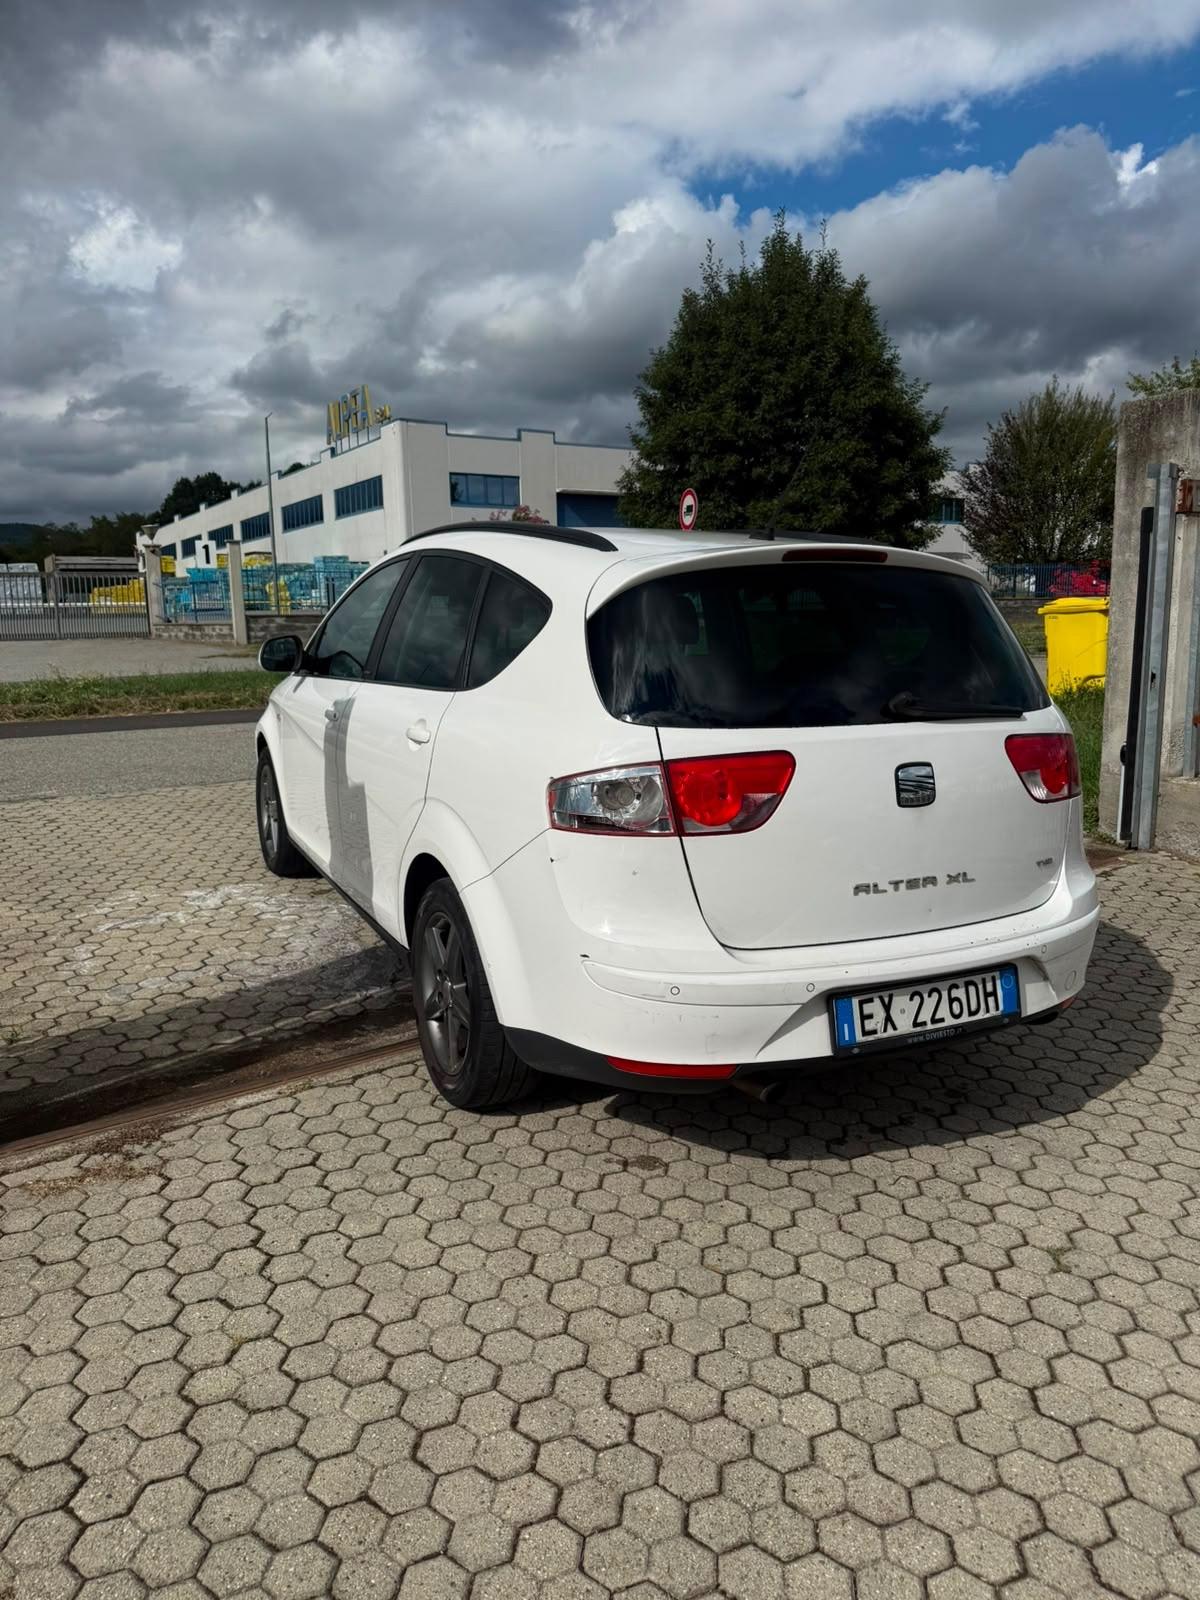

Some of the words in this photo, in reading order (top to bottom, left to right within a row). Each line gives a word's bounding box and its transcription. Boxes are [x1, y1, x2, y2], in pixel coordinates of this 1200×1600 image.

[202, 544, 210, 564] 1
[853, 876, 938, 896] ALTEA
[946, 872, 976, 885] XL
[858, 993, 898, 1037] EX
[909, 975, 1000, 1028] 226DH
